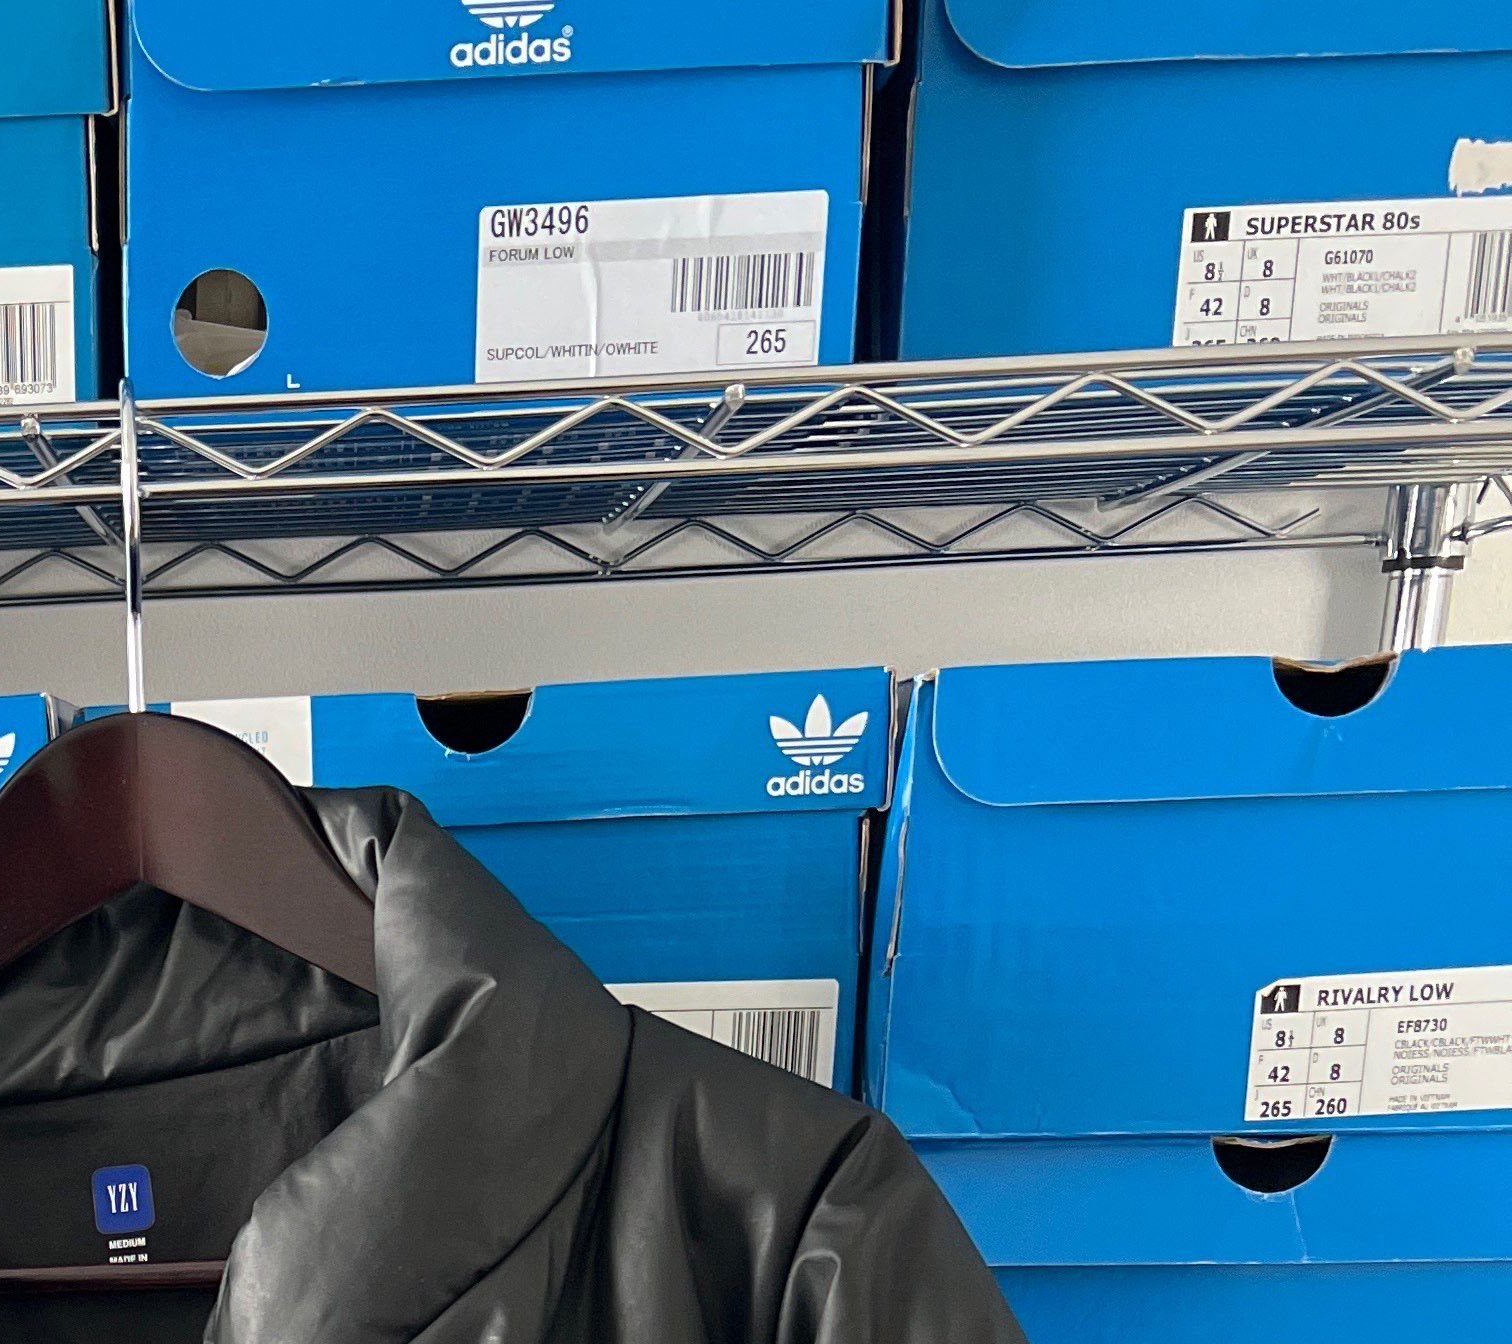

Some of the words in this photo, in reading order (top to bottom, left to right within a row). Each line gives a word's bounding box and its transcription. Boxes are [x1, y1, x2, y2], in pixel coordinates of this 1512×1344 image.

[450, 32, 572, 67] adidas
[491, 205, 589, 238] GW3496
[1246, 212, 1375, 236] SUPERSTAR
[1382, 212, 1420, 230] 80s
[489, 248, 539, 262] FORUM
[545, 246, 575, 260] LOW
[1325, 250, 1373, 265] G61070
[1263, 259, 1274, 277] 8
[1200, 297, 1223, 316] 42
[1260, 297, 1270, 316] 8
[746, 329, 787, 355] 265
[766, 768, 865, 796] adidas
[1317, 986, 1401, 1006] RIVALRY
[1409, 983, 1454, 1002] LOW
[1397, 1018, 1448, 1034] EF8730
[1334, 1027, 1344, 1044] 8
[1268, 1065, 1290, 1083] 42
[1330, 1063, 1341, 1080] 8
[1260, 1101, 1292, 1118] 265
[1315, 1098, 1347, 1115] 260
[107, 1182, 138, 1214] YZY
[109, 1237, 146, 1249] MEDIUM
